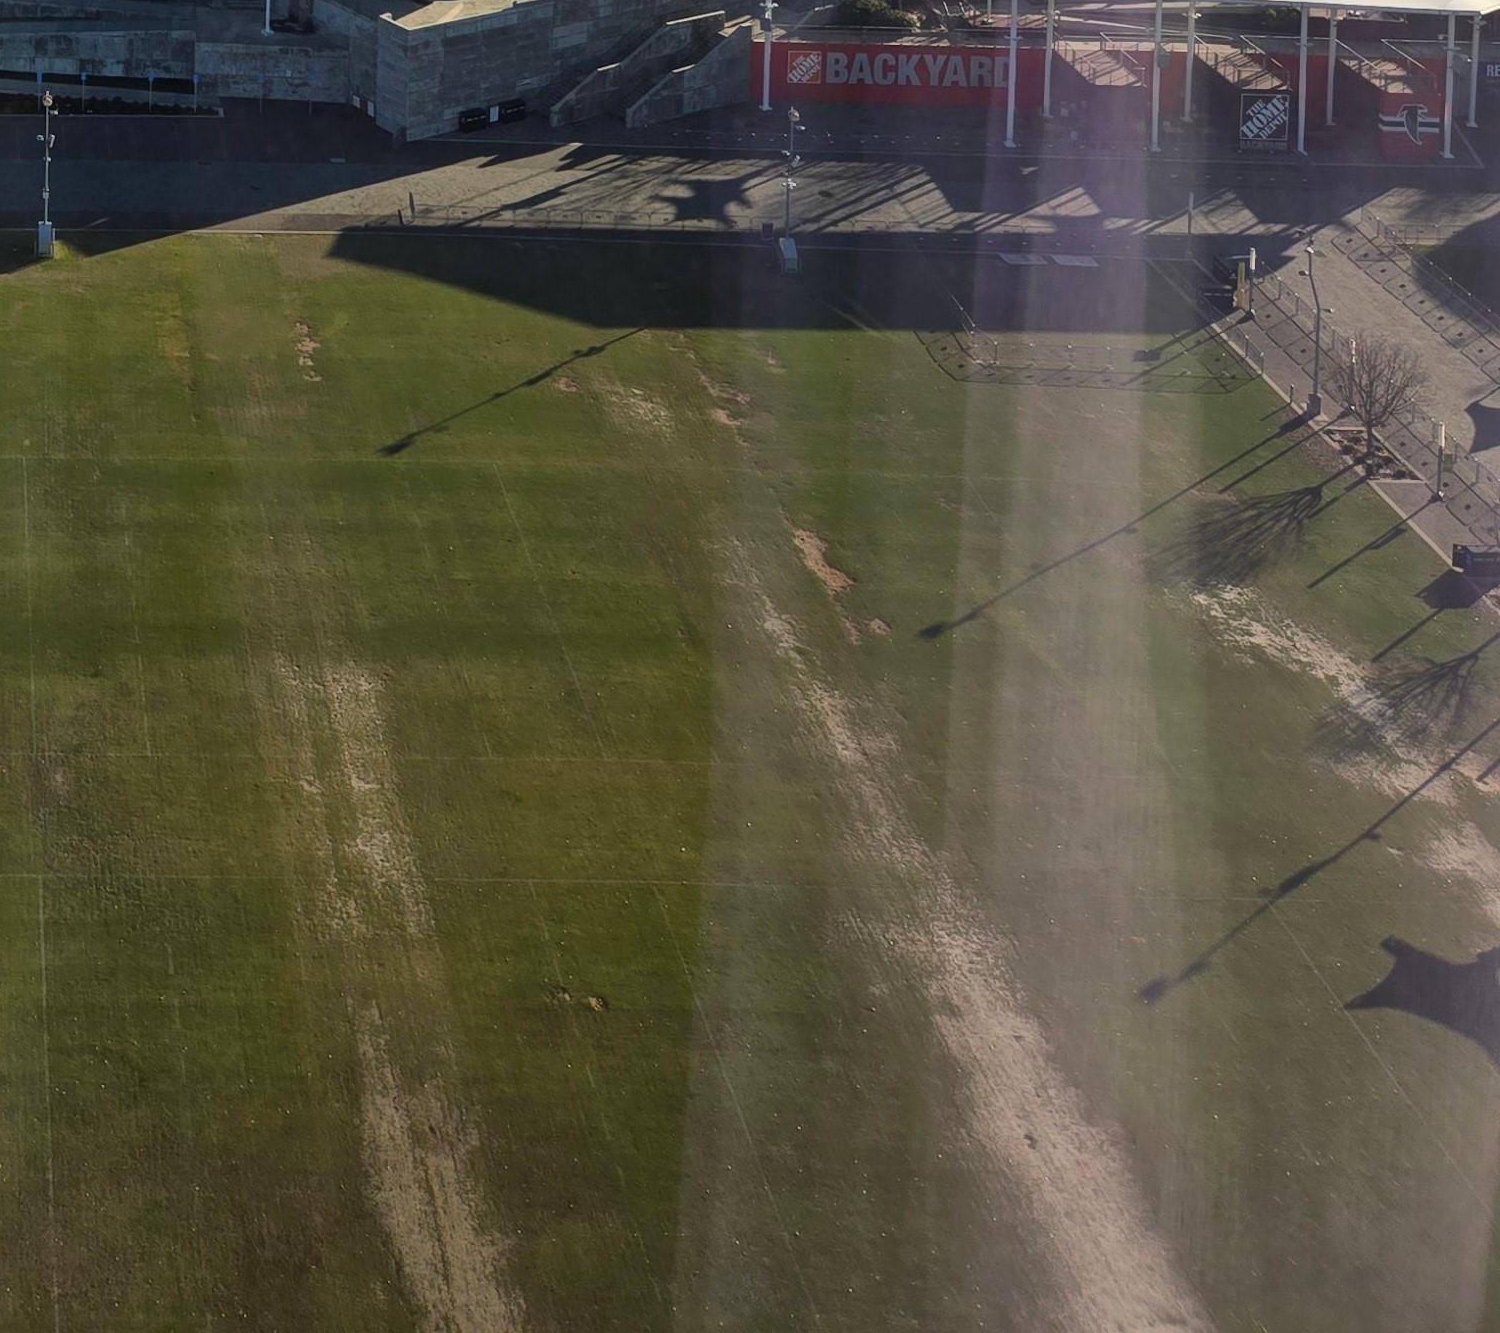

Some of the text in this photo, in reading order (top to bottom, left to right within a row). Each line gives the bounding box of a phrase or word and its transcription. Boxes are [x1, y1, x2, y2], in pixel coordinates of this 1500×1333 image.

[787, 53, 821, 83] HOME
[1240, 94, 1288, 138] HOME
[1246, 99, 1266, 117] THE
[1258, 112, 1288, 139] DEPOT
